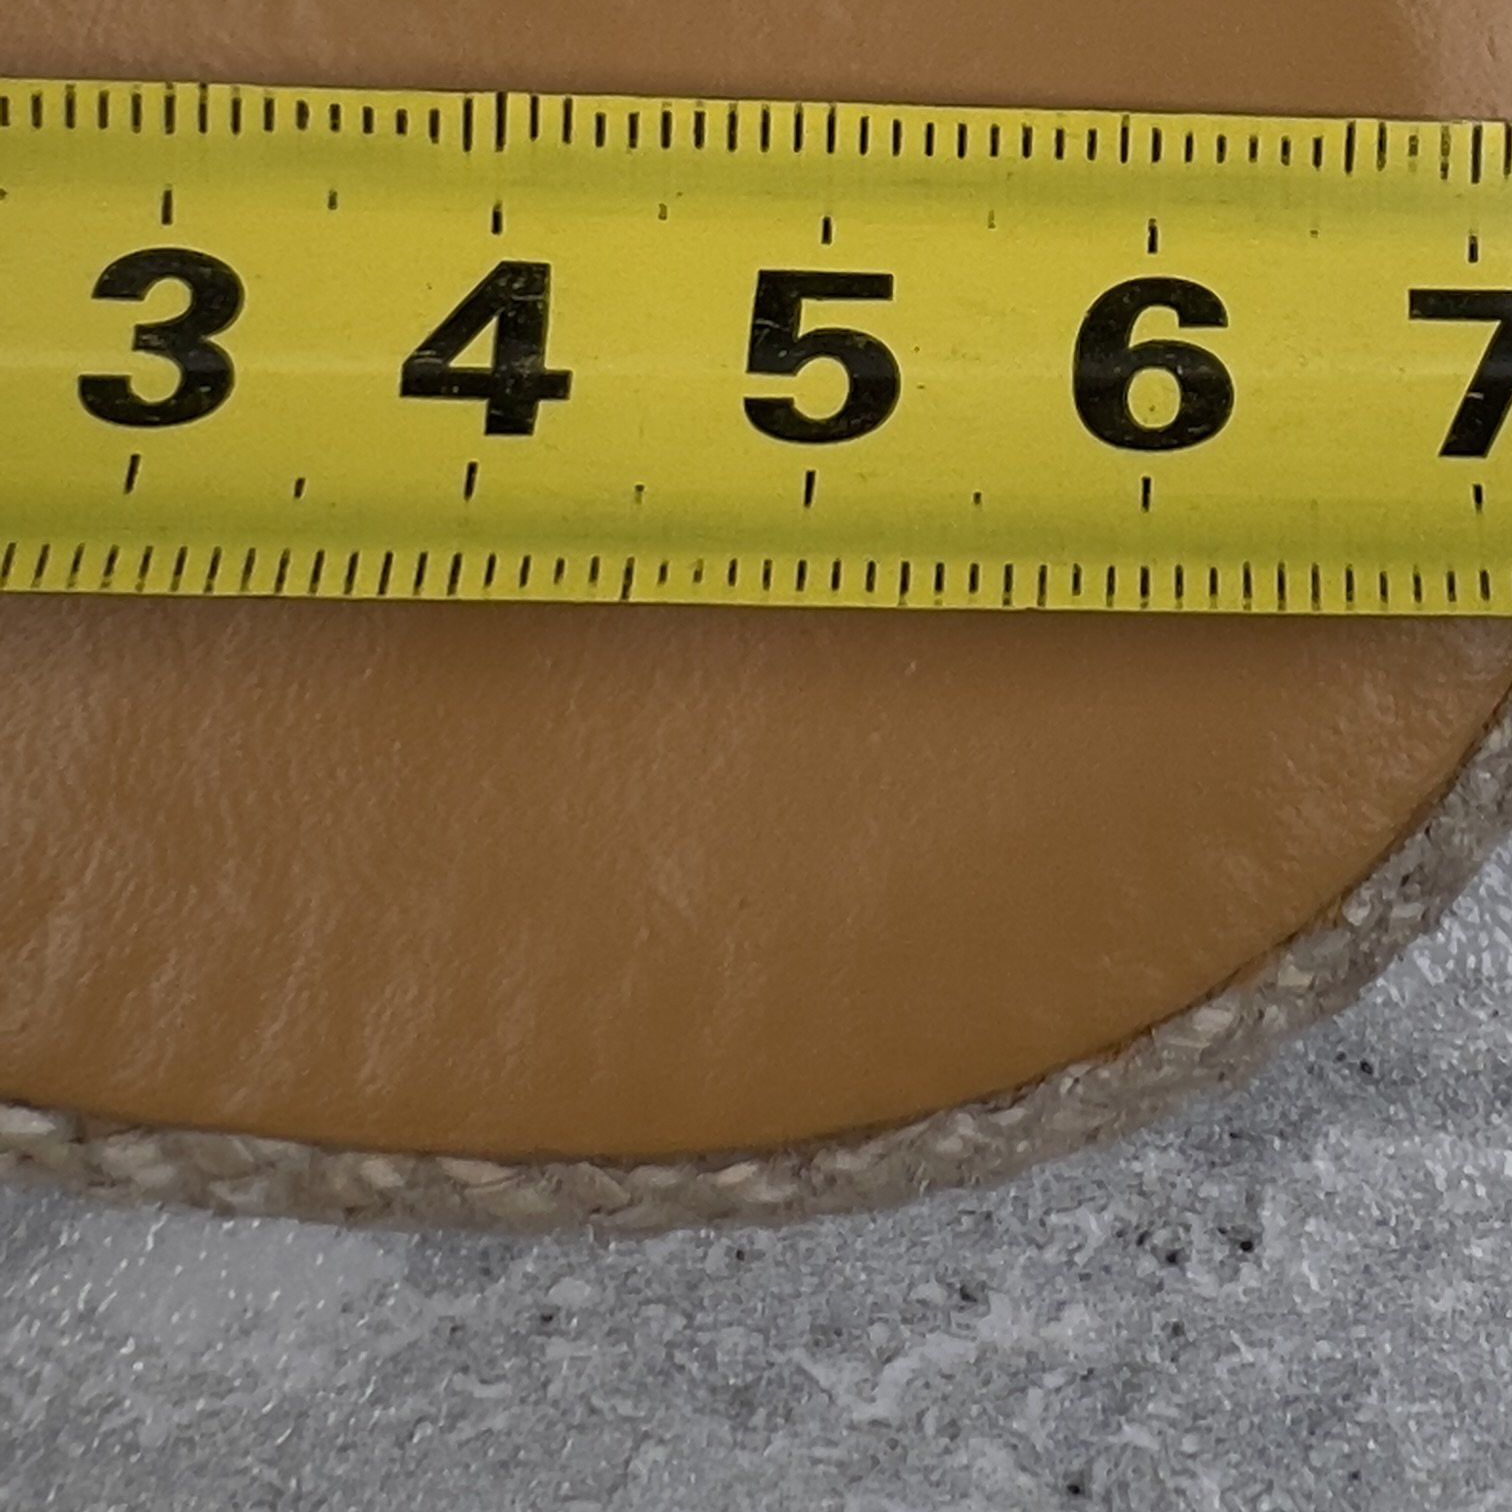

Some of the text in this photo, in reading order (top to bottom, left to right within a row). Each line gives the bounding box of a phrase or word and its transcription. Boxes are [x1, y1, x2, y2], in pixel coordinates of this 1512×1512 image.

[79, 248, 244, 428] 3
[400, 260, 571, 436] 4
[743, 270, 901, 445] 5
[1072, 277, 1234, 452] 6
